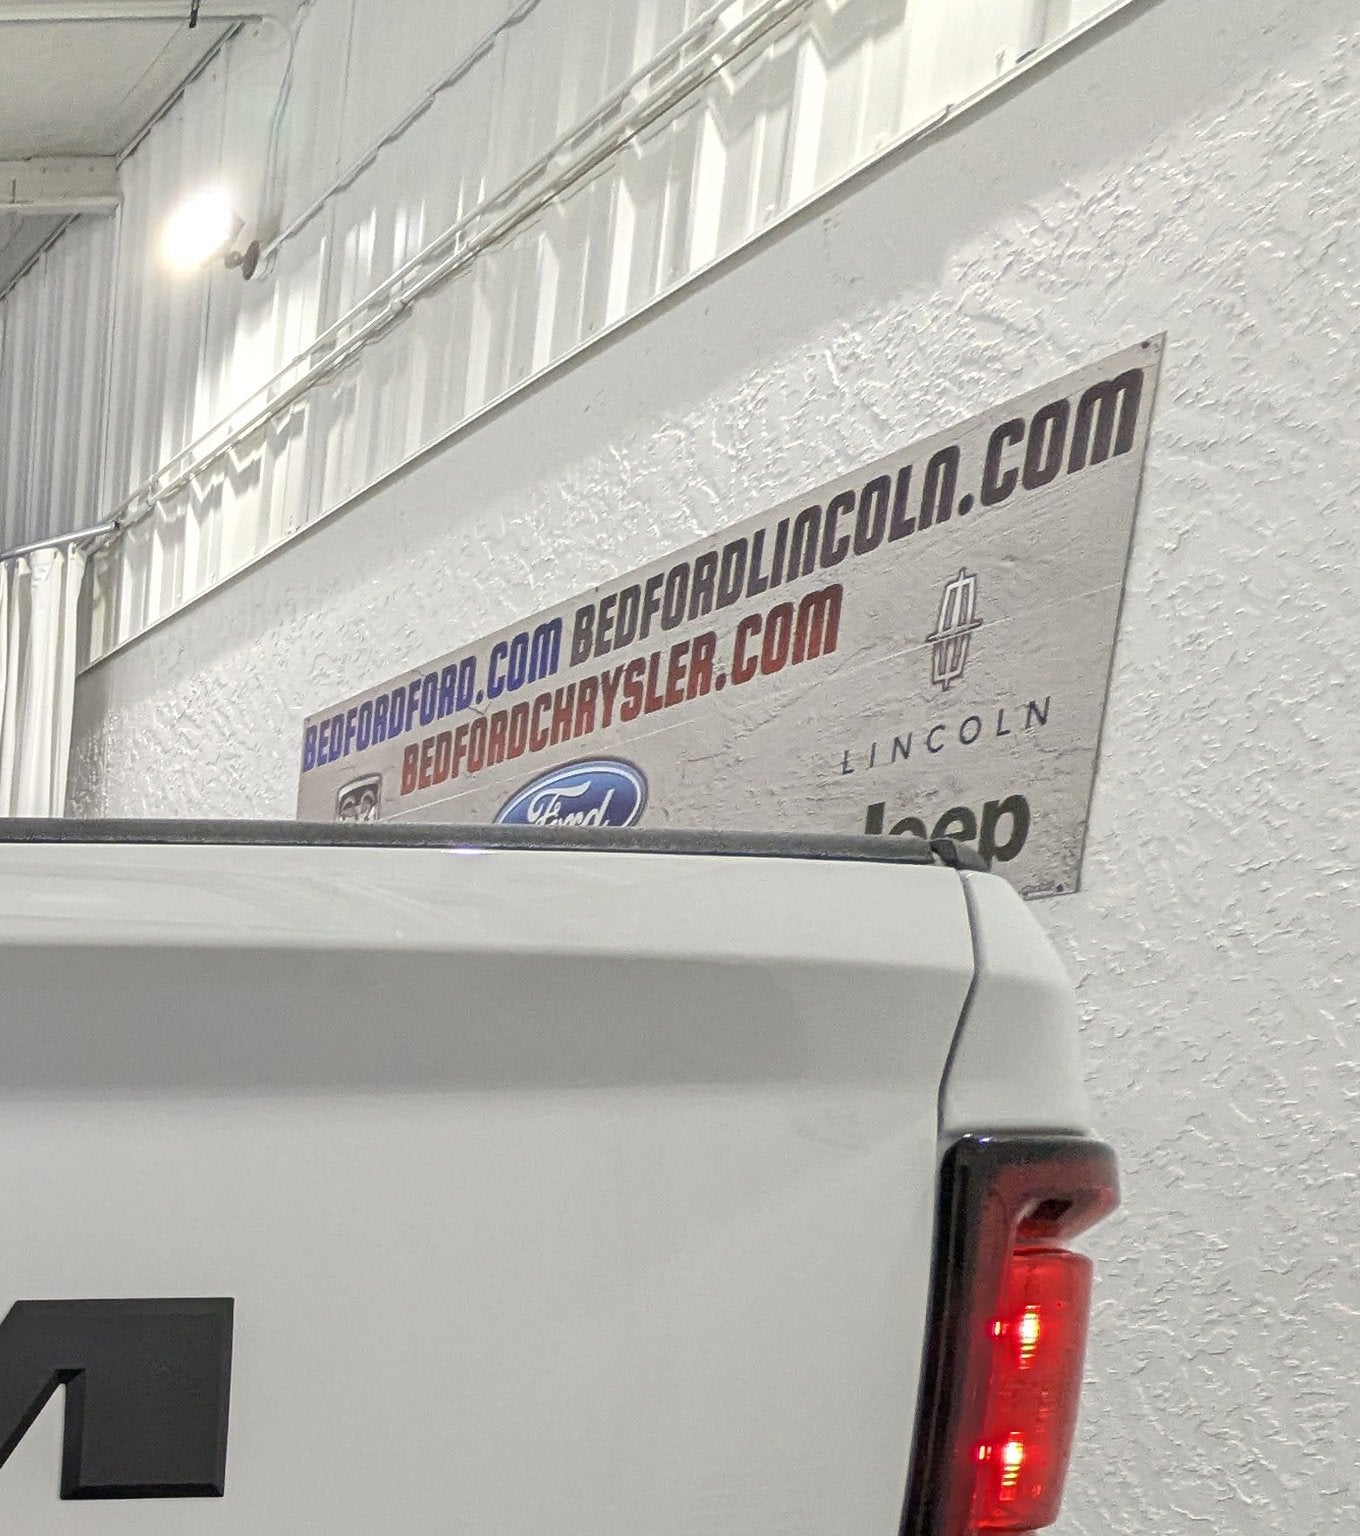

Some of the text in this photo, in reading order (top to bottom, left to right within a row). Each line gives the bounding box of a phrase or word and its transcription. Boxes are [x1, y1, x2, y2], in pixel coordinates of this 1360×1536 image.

[302, 367, 1145, 771] BEDFORDFORD.COM BEDFORDLINCOLN.COM
[399, 583, 844, 796] BEDFORDCHRYSLER.COM
[842, 695, 1051, 775] LINCOLN
